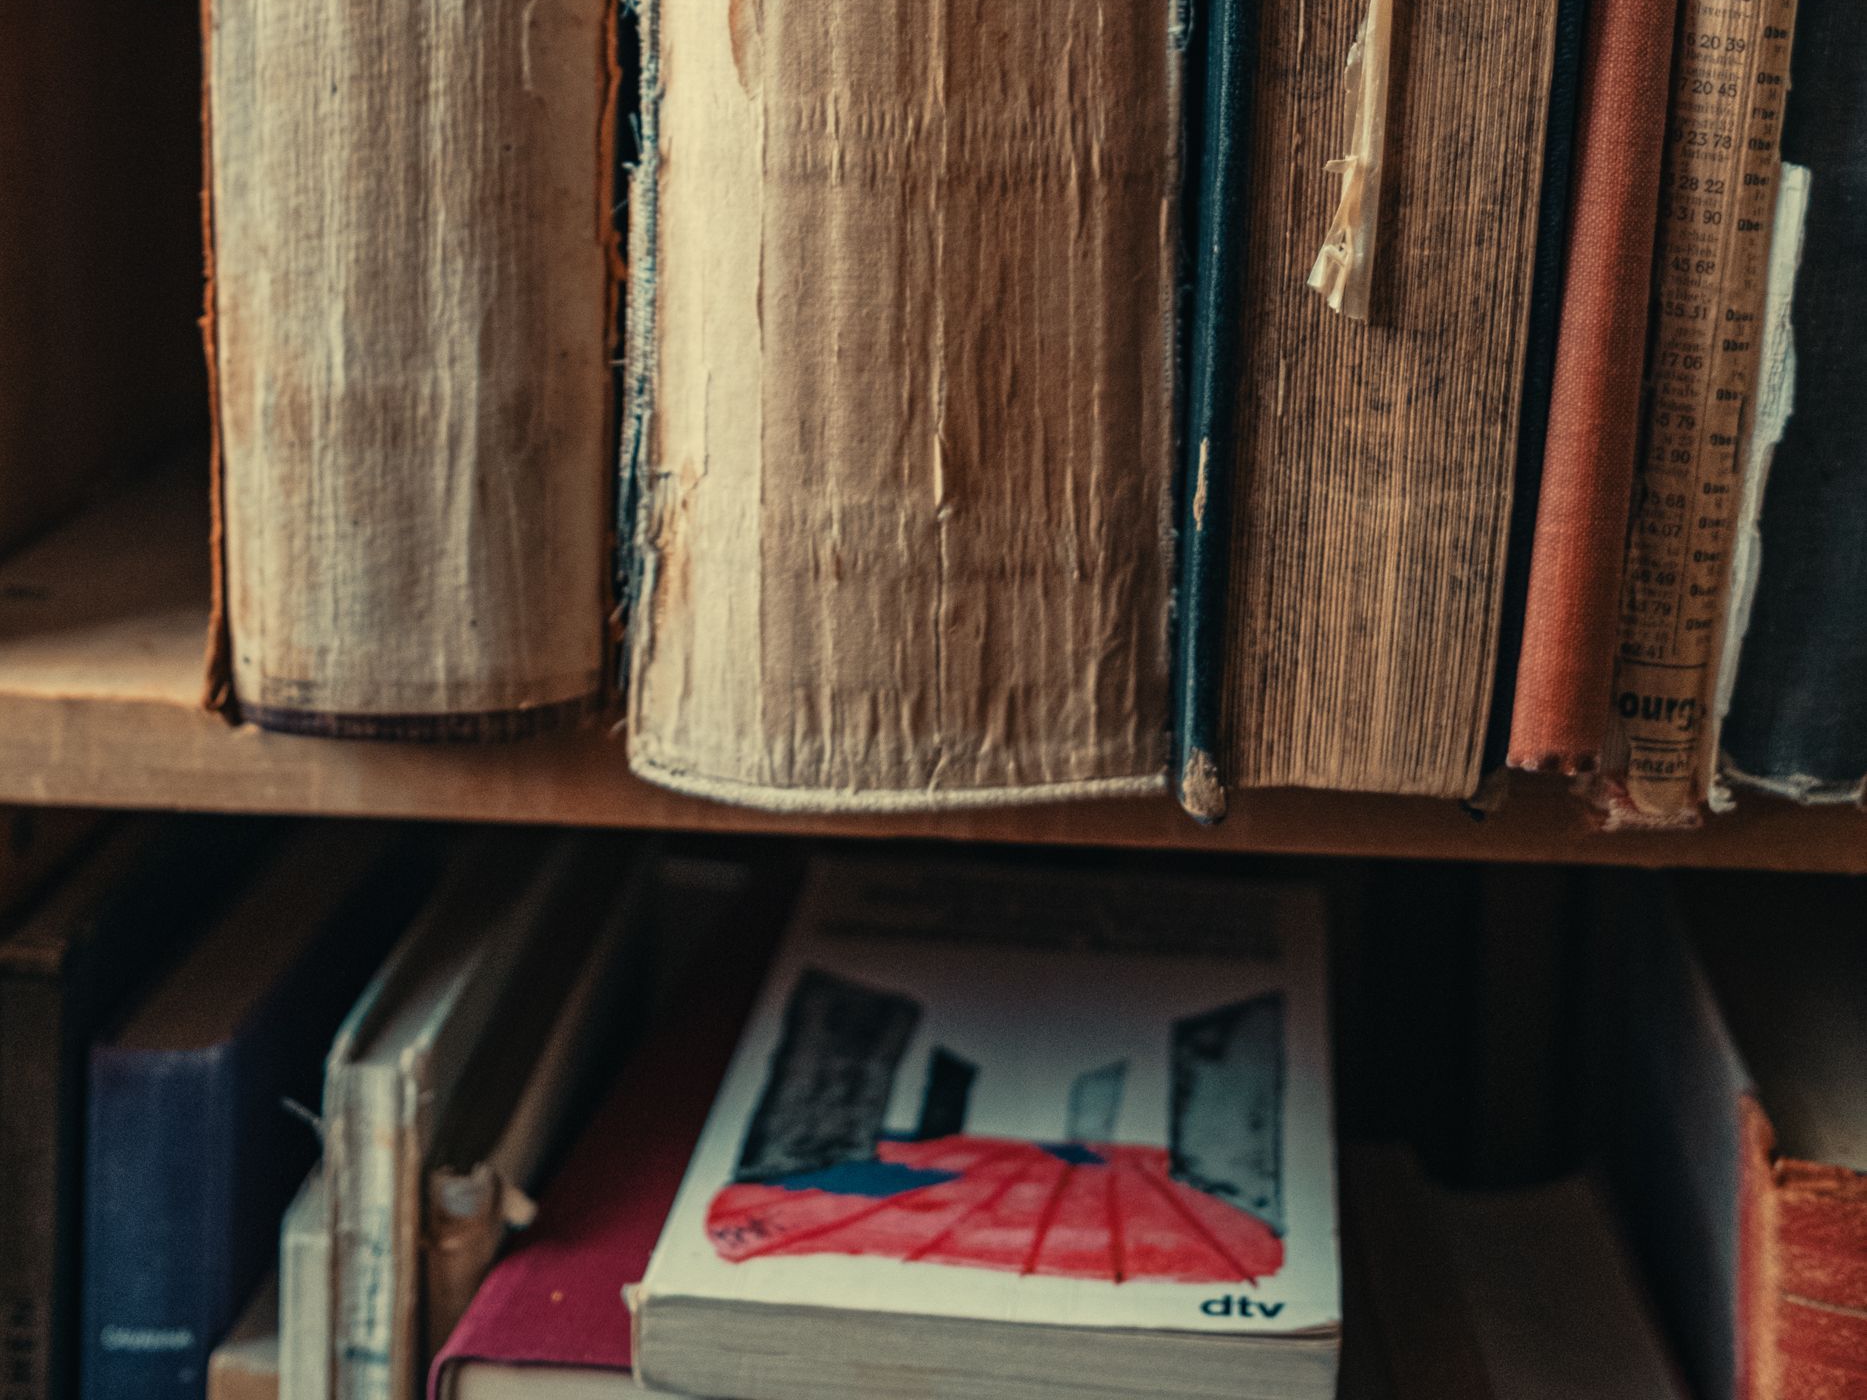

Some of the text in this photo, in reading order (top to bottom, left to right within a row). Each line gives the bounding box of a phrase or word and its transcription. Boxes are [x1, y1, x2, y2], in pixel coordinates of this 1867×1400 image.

[1700, 34, 1721, 49] 20
[1725, 37, 1746, 53] 39
[1680, 77, 1738, 98] 7 20 45
[1687, 131, 1707, 146] 23
[1679, 175, 1699, 191] 28
[1704, 179, 1725, 194] 22
[1677, 206, 1722, 225] 31 90
[1672, 256, 1716, 275] 45 68
[1683, 355, 1703, 370] 06
[1662, 524, 1683, 538] 07
[1200, 1295, 1284, 1318] dtv
